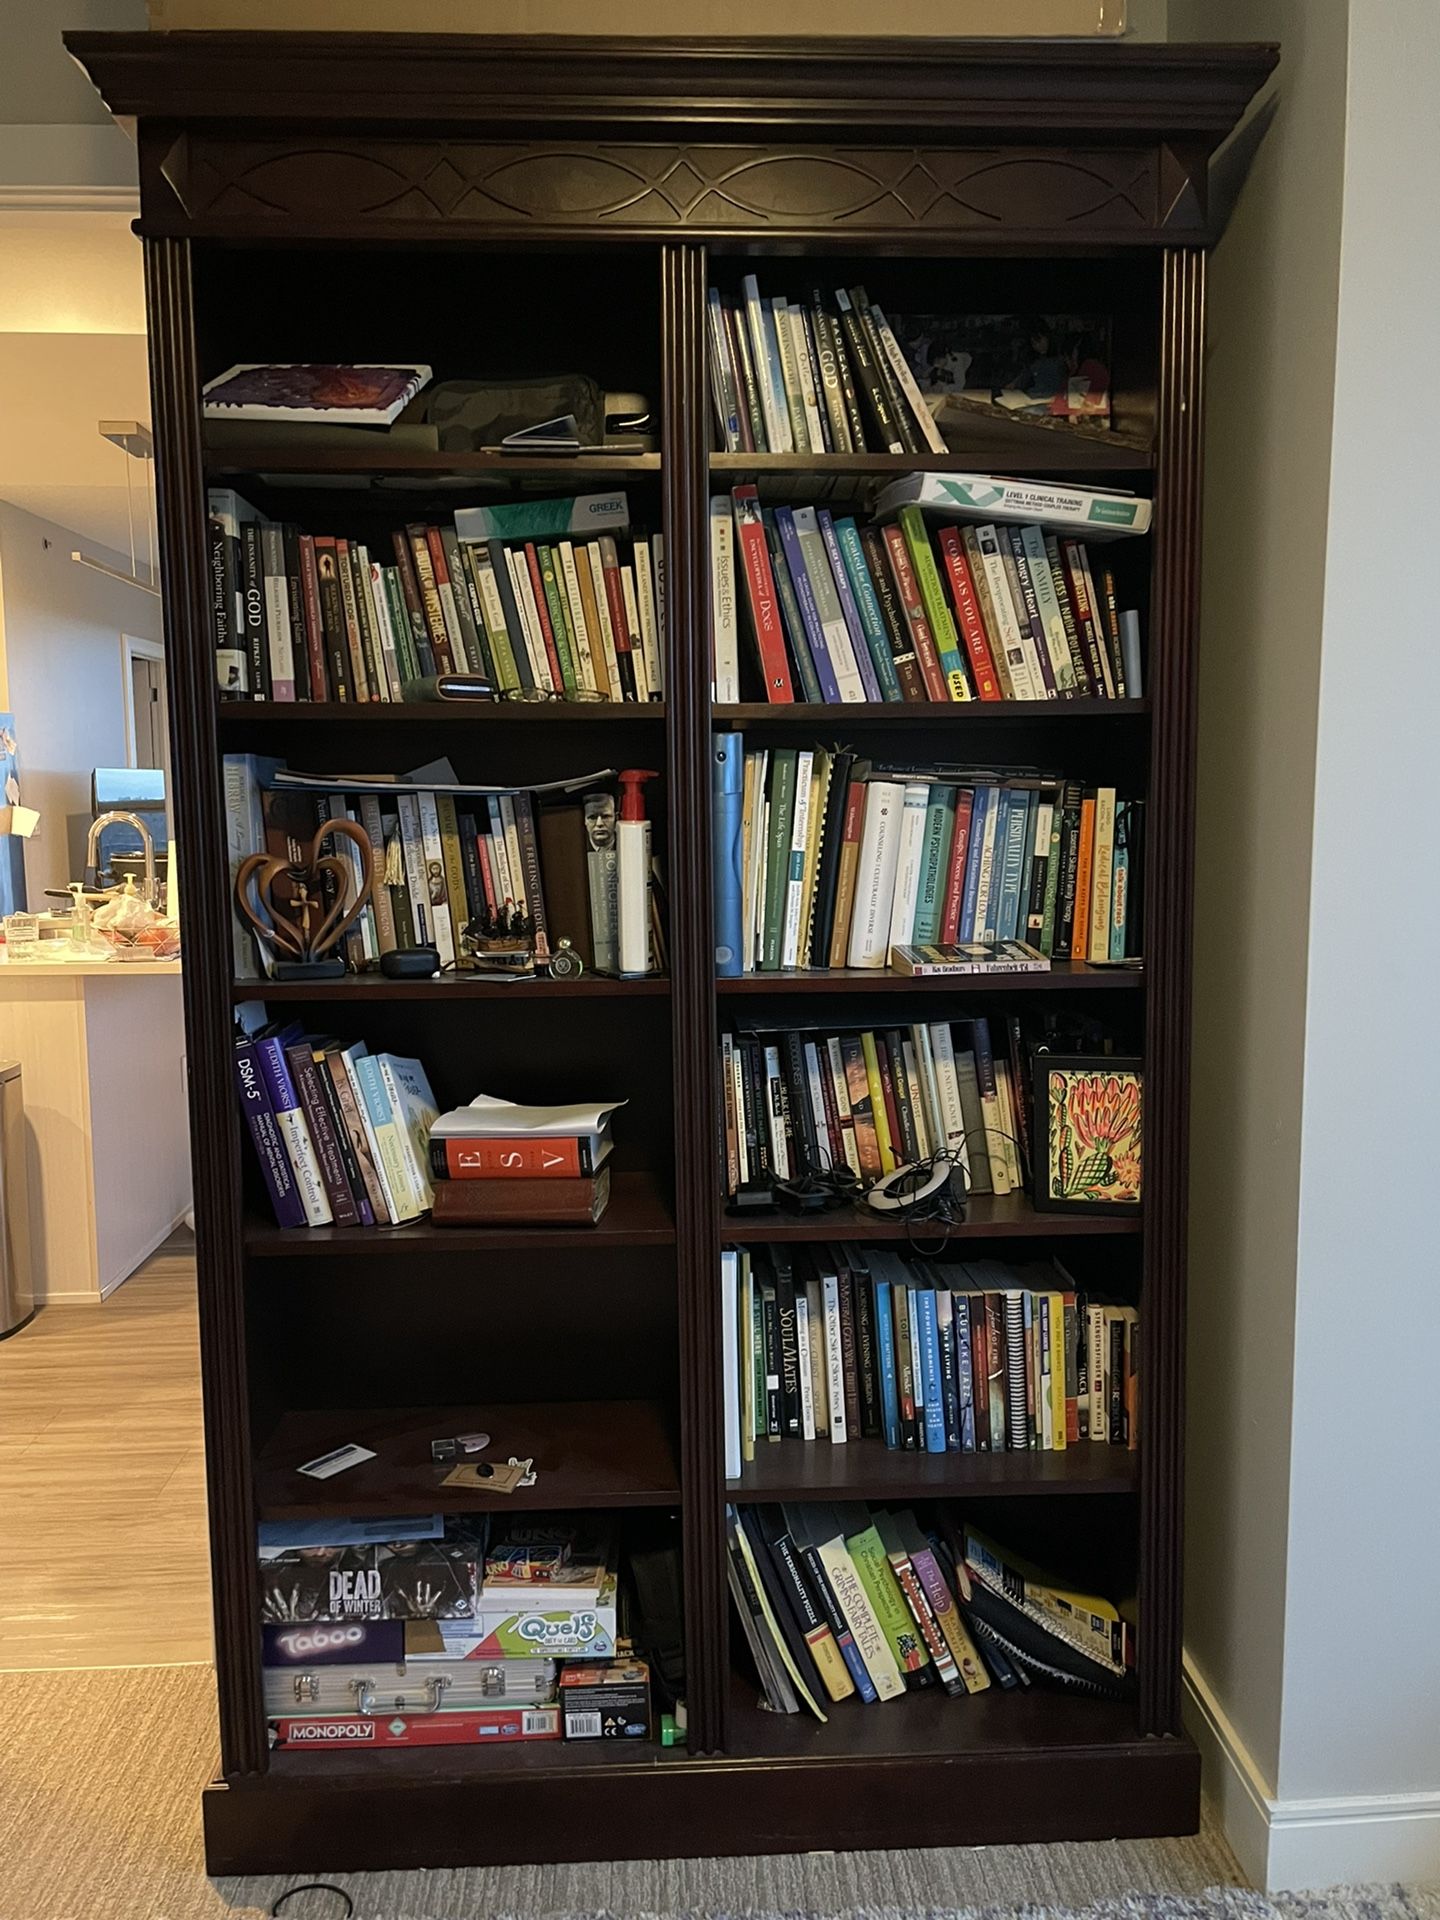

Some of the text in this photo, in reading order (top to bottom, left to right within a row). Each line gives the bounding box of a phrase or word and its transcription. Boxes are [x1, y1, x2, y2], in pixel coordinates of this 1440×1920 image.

[832, 317, 849, 382] RADICAL
[792, 406, 807, 449] PACKER
[850, 407, 864, 449] PLATT
[589, 500, 624, 513] GREEK
[1005, 490, 1025, 499] LEVEL
[1030, 493, 1055, 502] CLINICAL
[1056, 496, 1083, 506] TRAINING
[247, 528, 257, 543] THE
[821, 517, 847, 590] SYSTEMIC SEX THERAPY
[247, 544, 257, 579] INSANITY
[542, 551, 550, 566] MAY
[638, 550, 647, 573] WHOSE
[719, 555, 731, 589] Issues
[1012, 537, 1040, 620] The Angry Heart
[1029, 540, 1053, 605] The FAMILY
[211, 541, 229, 644] Neighboring Faiths
[416, 550, 432, 581] BOOK
[424, 590, 447, 644] MYSTERIES
[565, 559, 588, 643] THE LISTENING LIFE
[640, 574, 650, 595] LAND?
[749, 539, 763, 589] ENCYCLOPEDIA
[759, 600, 772, 632] DOGS
[845, 527, 863, 571] Created
[861, 583, 883, 637] Connection
[866, 533, 903, 651] Counseling and Psychotherapy
[946, 539, 985, 656] COME AS YOU ARE
[1048, 546, 1068, 597] SHAMELESS
[1060, 607, 1075, 635] NADIA
[246, 589, 262, 627] GOD
[290, 576, 303, 644] Envisioning Islam
[340, 557, 359, 653] TORTURED FOR CHRIST
[642, 596, 651, 618] WHOSE
[720, 597, 733, 629] Ethics
[468, 646, 479, 669] TRIPP
[904, 666, 914, 681] Tan
[952, 674, 964, 698] USED
[226, 764, 241, 819] HEBREW
[799, 760, 811, 798] Practicum
[368, 801, 385, 878] THE JESUS QUEST
[775, 804, 788, 848] The Life Span
[795, 807, 808, 848] Internship
[972, 818, 984, 848] Counseling
[1053, 814, 1061, 828] MAY
[924, 808, 944, 904] MODERN PSYCHOPATHOLOGIES
[971, 849, 981, 858] and
[1003, 808, 1026, 895] PERSONALITY TYPE
[1070, 830, 1079, 856] Essential
[866, 821, 887, 935] COUNSELING CULTURALLY DIVERSE
[949, 829, 968, 921] Groups: Process and Practice
[968, 860, 981, 895] Educational
[976, 845, 997, 923] ACHING FOR LOVE
[1068, 857, 1079, 874] Skills
[525, 847, 545, 934] FREEING THEOLO
[606, 852, 618, 936] BONHOEFFER
[1064, 881, 1076, 900] Family
[1095, 845, 1111, 931] Radical Belonging
[1063, 901, 1074, 924] Therapy
[238, 1058, 261, 1102] DSM-5
[265, 1045, 292, 1109] JUDITH VIORST
[789, 1034, 802, 1086] BLOODLINES
[303, 1067, 321, 1105] Selecting
[362, 1060, 388, 1122] JUDITH VIORST
[910, 1083, 922, 1118] UNlost
[313, 1105, 333, 1142] Effective
[780, 1086, 793, 1138] BLACK LIKE ME
[256, 1115, 286, 1198] MANUAL OF MENTAL DISORDERS
[263, 1112, 291, 1190] DIAGNOSTIC AND STATISTICAL
[289, 1126, 320, 1204] Imperfect Control
[322, 1143, 344, 1185] Treatments
[385, 1134, 409, 1192] Necessary Losses
[859, 1286, 870, 1326] MORNING
[925, 1314, 933, 1334] POWER
[862, 1335, 873, 1369] EVENING
[883, 1312, 893, 1370] WORSHIP MATTERS
[899, 1318, 913, 1395] told Allender
[927, 1336, 934, 1345] OF
[958, 1304, 972, 1399] BLUE LIKE JAZZ
[1094, 1311, 1102, 1379] STRENGTHSFINDER
[927, 1347, 936, 1381] MOMENTS
[864, 1372, 875, 1405] SPURGEON
[329, 1570, 382, 1600] DEAD
[779, 1541, 818, 1625] THE PERSONALITY PUZZLE
[859, 1550, 893, 1619] Christian Perspective
[868, 1546, 883, 1568] Social
[877, 1567, 898, 1608] Psychology
[926, 1569, 946, 1609] The Help
[329, 1601, 380, 1614] OF WINTER
[520, 1614, 596, 1642] Quelf
[843, 1574, 880, 1645] THE COMPLETE
[280, 1627, 364, 1654] Taboo
[820, 1641, 834, 1664] FUNDER
[845, 1606, 865, 1631] FAIRY
[855, 1630, 876, 1660] TALES
[943, 1618, 962, 1654] STOCKETT
[950, 1616, 968, 1651] KATHRYN
[292, 1725, 373, 1739] MONOPOLY
